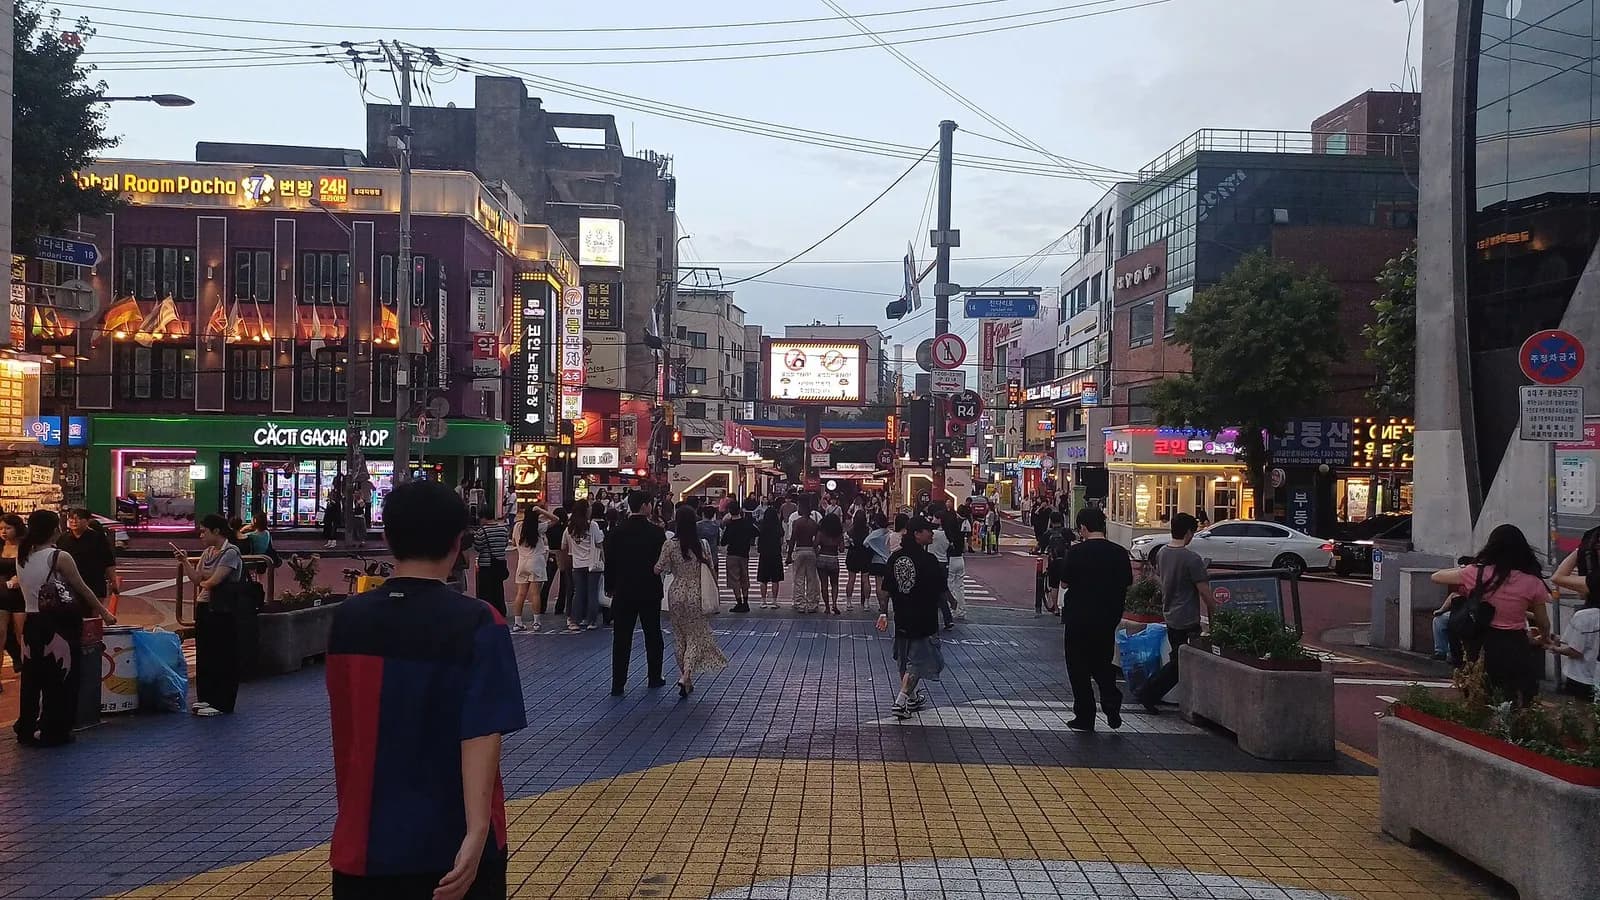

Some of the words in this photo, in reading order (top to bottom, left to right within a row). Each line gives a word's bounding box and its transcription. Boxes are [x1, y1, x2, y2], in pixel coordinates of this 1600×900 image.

[124, 174, 175, 193] Room
[177, 175, 237, 195] Pocha
[250, 176, 264, 201] 7
[279, 179, 314, 198] 번방
[320, 178, 347, 195] 24H
[84, 250, 94, 259] 18
[1530, 352, 1577, 363] 주정차금지
[957, 405, 975, 417] R4
[300, 428, 347, 446] GACHA
[1153, 440, 1188, 456] 코인
